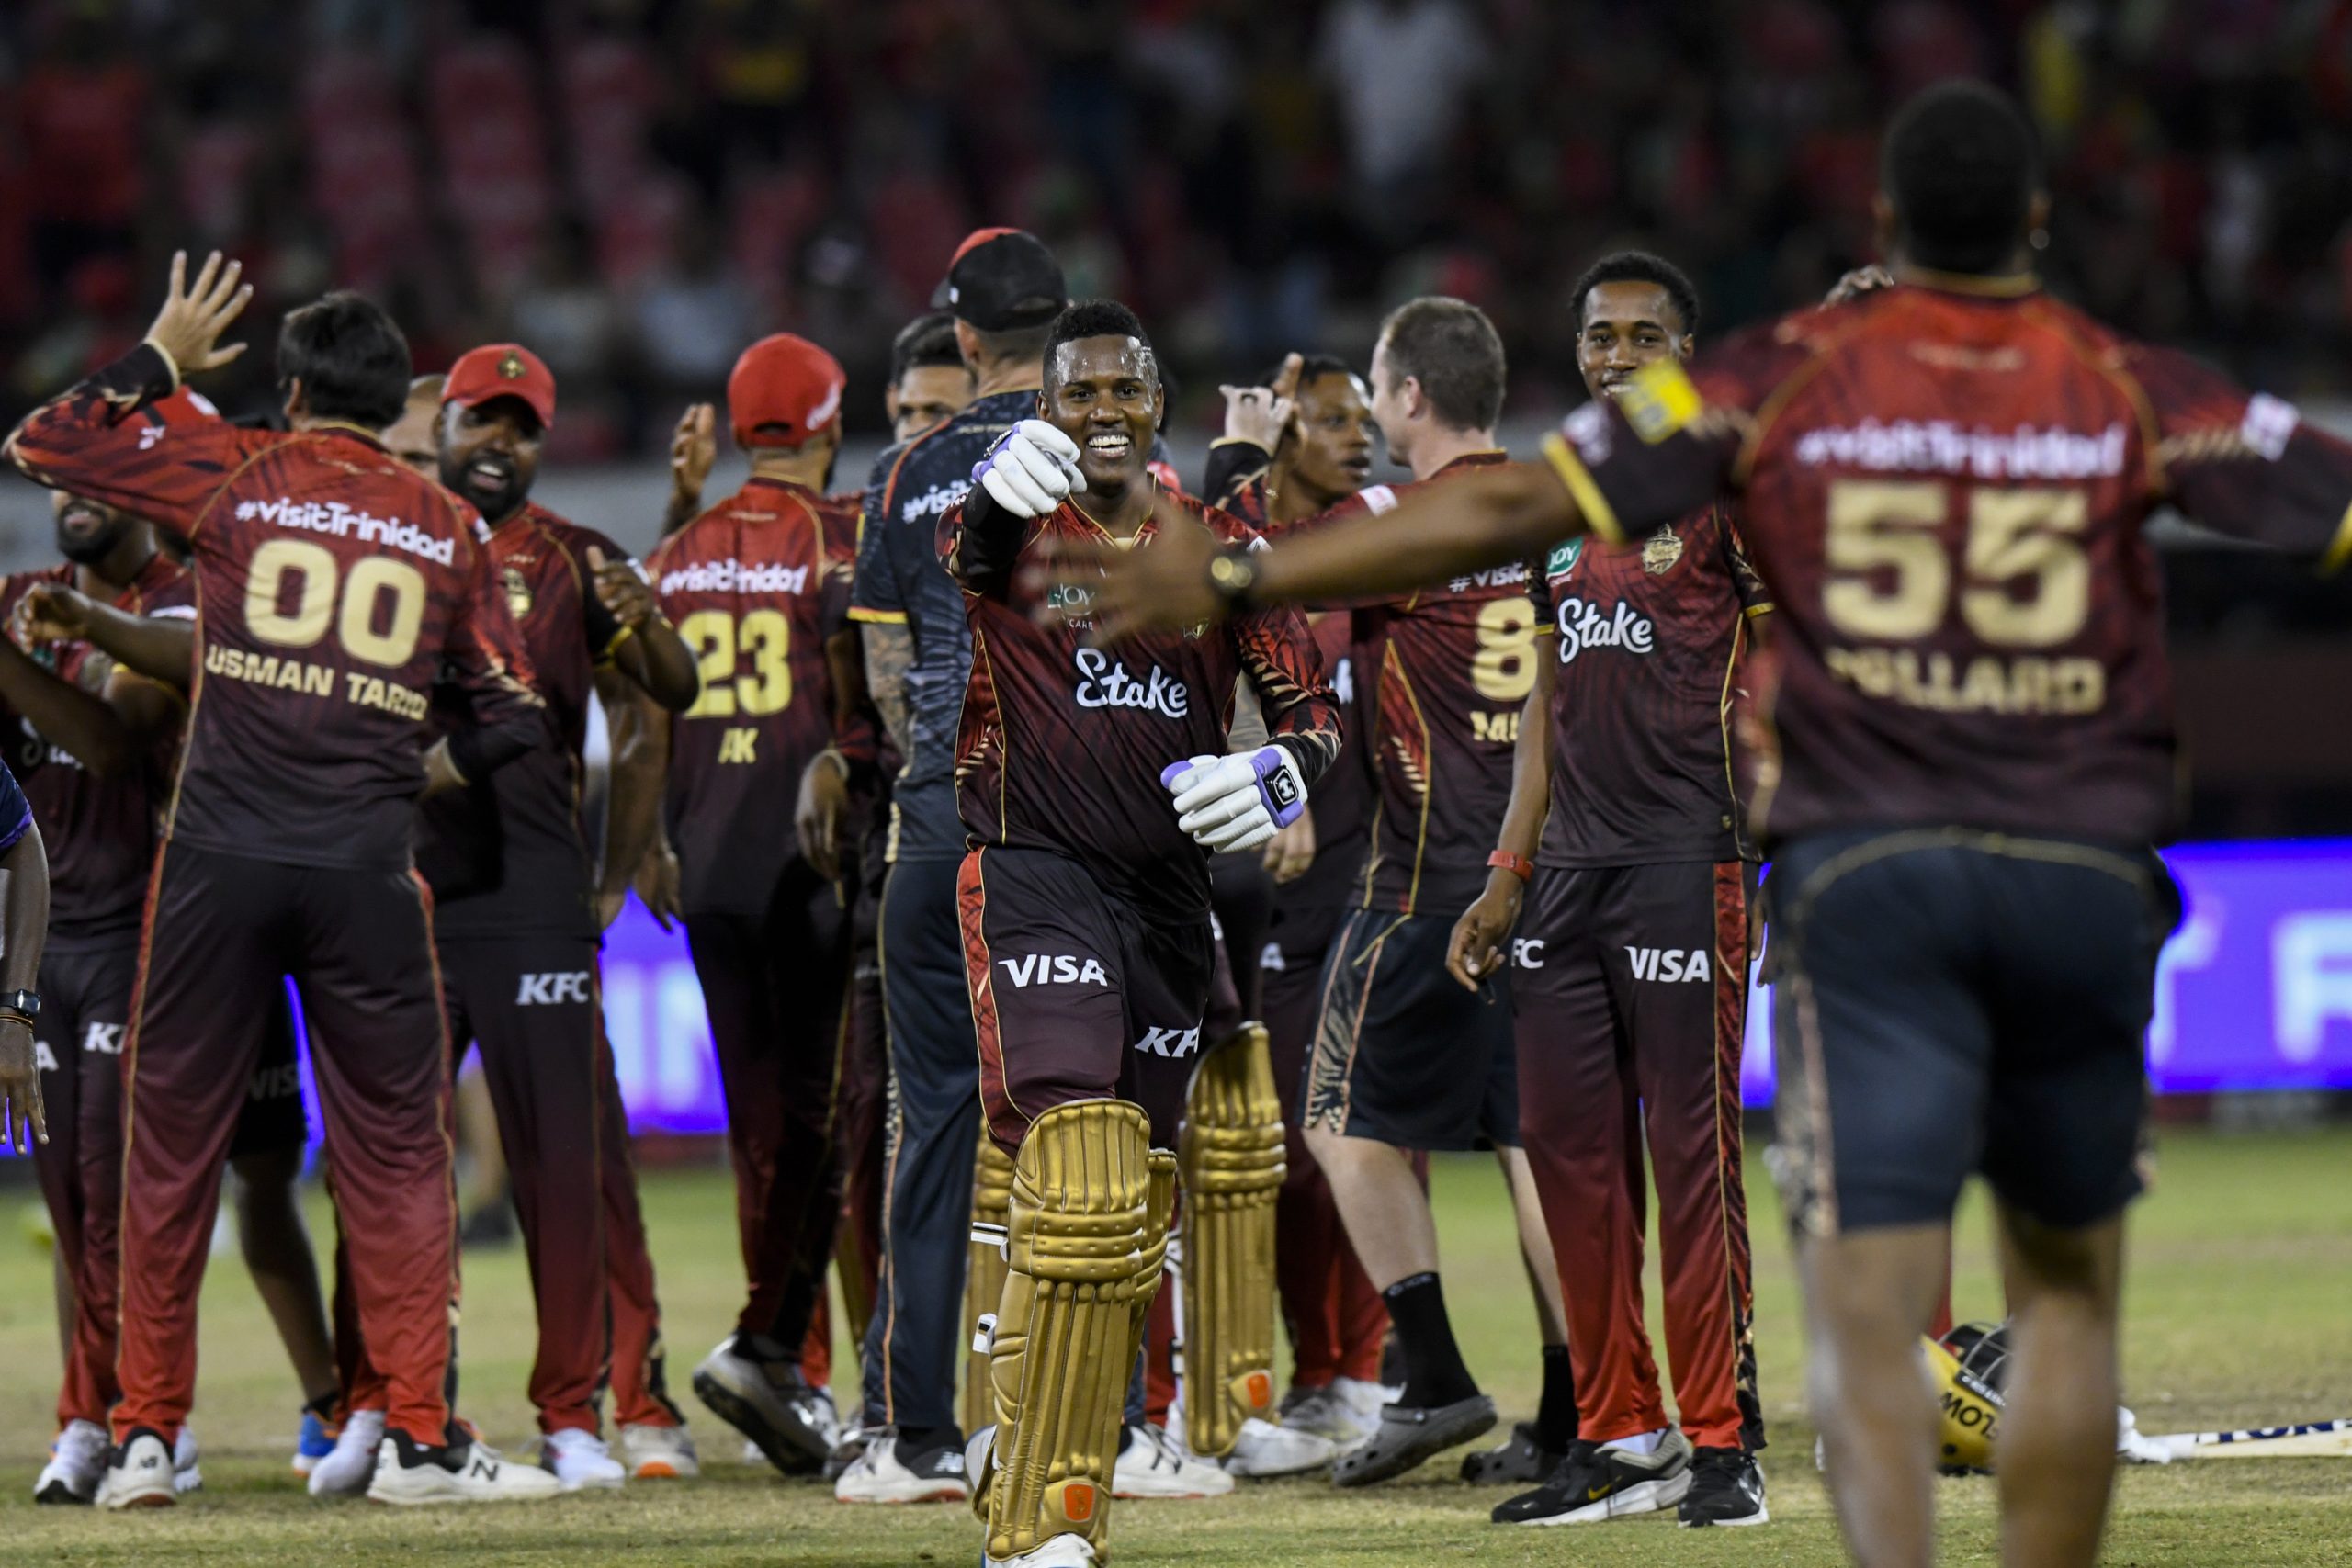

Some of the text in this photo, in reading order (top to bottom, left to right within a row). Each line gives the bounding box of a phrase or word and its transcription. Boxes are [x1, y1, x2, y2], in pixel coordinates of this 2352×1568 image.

[235, 497, 455, 567] #visitTrinidad
[1822, 479, 2091, 648] 55
[244, 537, 426, 669] 00
[1558, 597, 1653, 664] Stake
[205, 644, 335, 697] USMAN
[678, 607, 793, 720] 23
[1075, 647, 1188, 718] Stake
[998, 953, 1108, 987] VISA
[1510, 937, 1545, 969] FC
[1623, 945, 1711, 983] VISA
[516, 970, 590, 1006] KFC
[1134, 1025, 1199, 1058] KF
[248, 1064, 300, 1100] VIS
